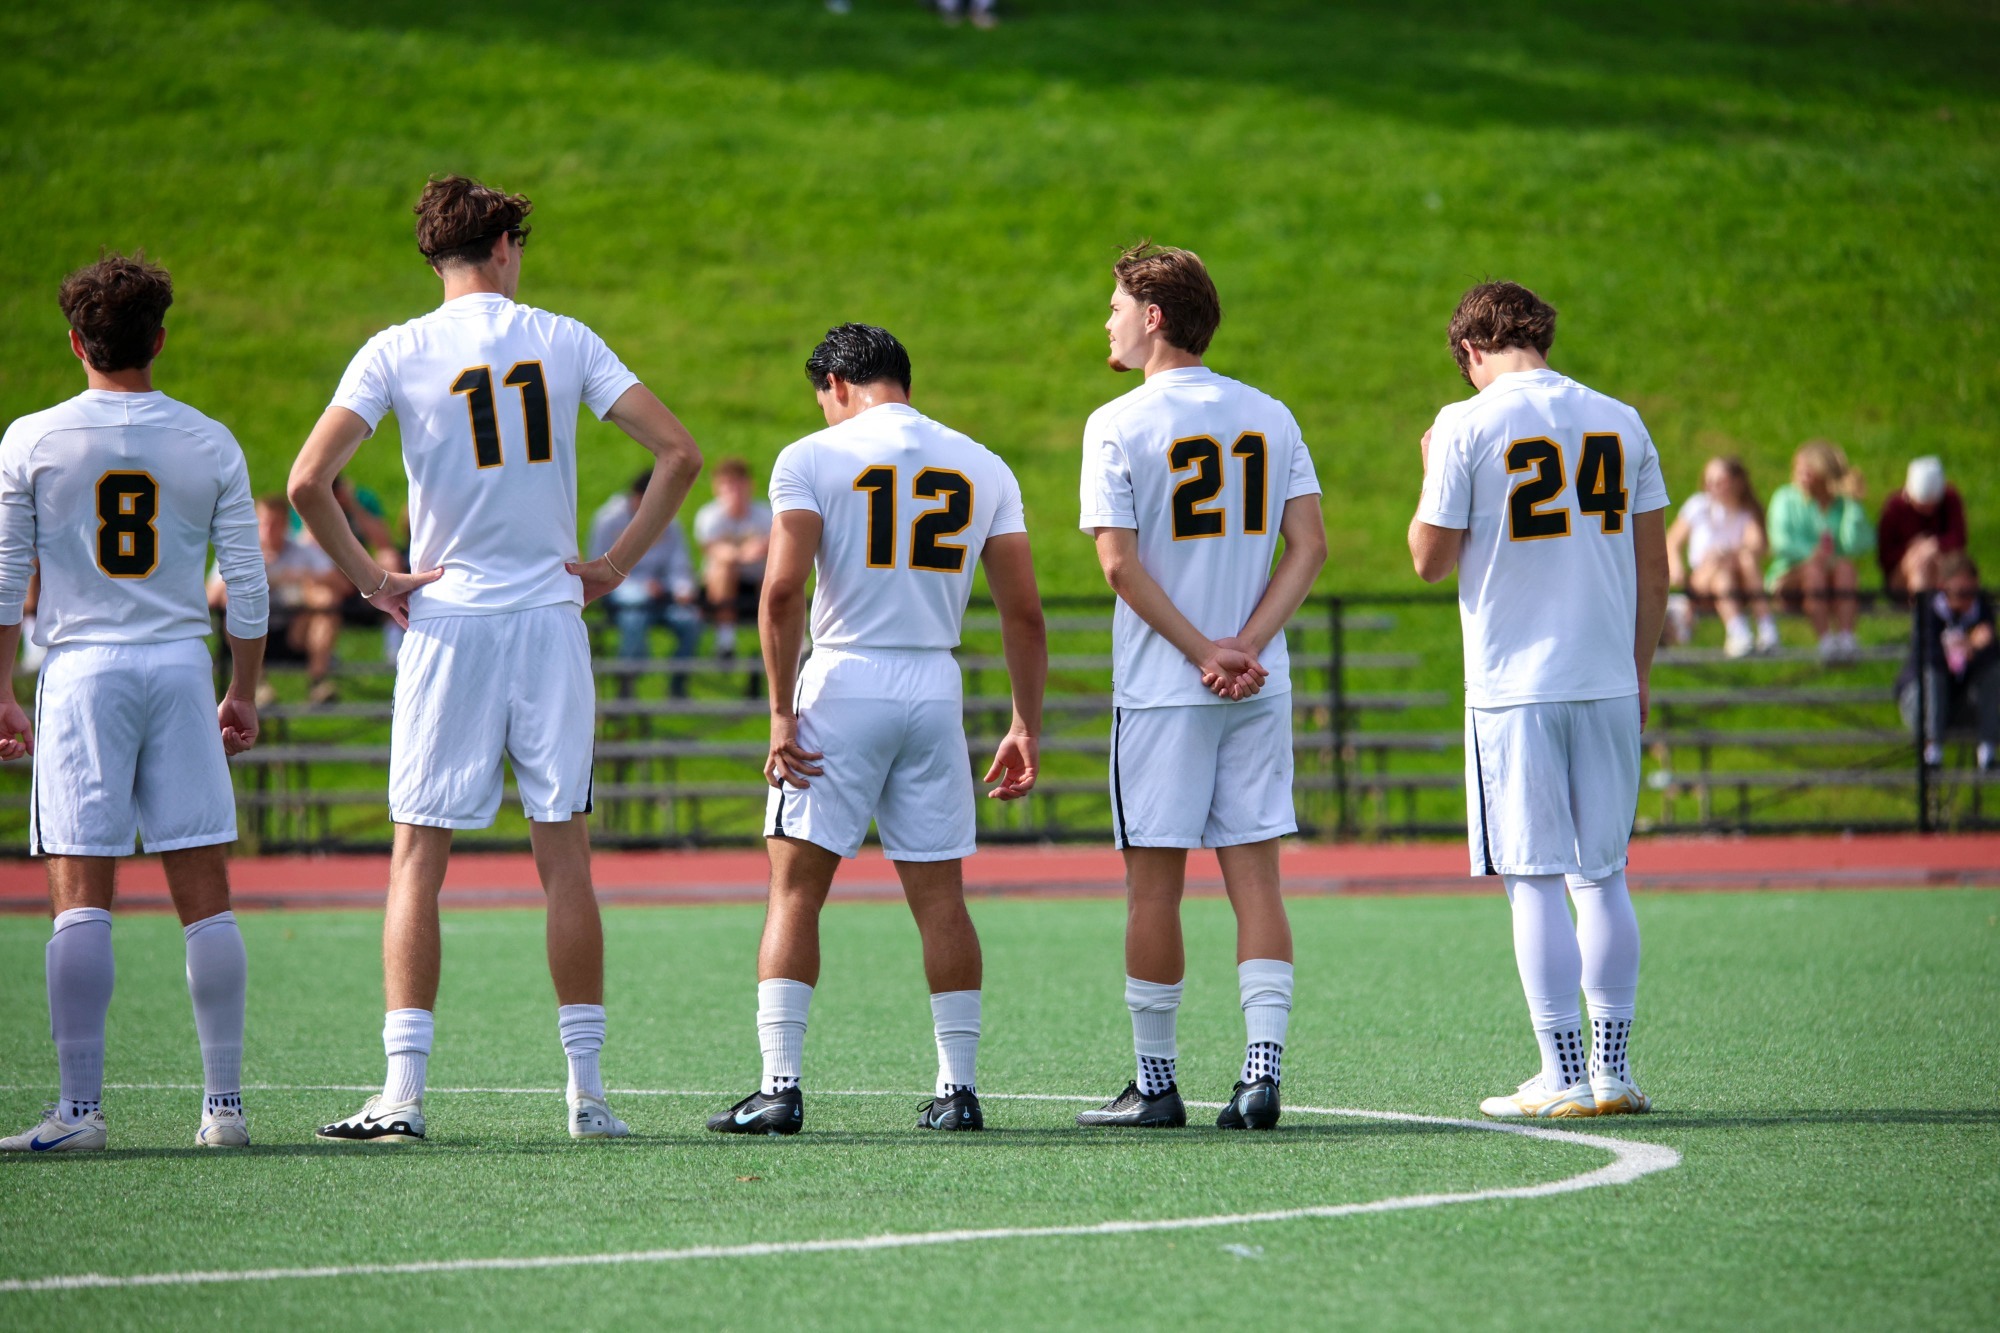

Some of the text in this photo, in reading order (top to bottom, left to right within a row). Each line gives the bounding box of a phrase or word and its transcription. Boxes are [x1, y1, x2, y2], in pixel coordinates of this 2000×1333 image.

[450, 360, 553, 469] 11
[95, 469, 160, 579] 8
[853, 464, 974, 574] 12
[1167, 430, 1268, 542] 21
[1504, 431, 1629, 542] 24
